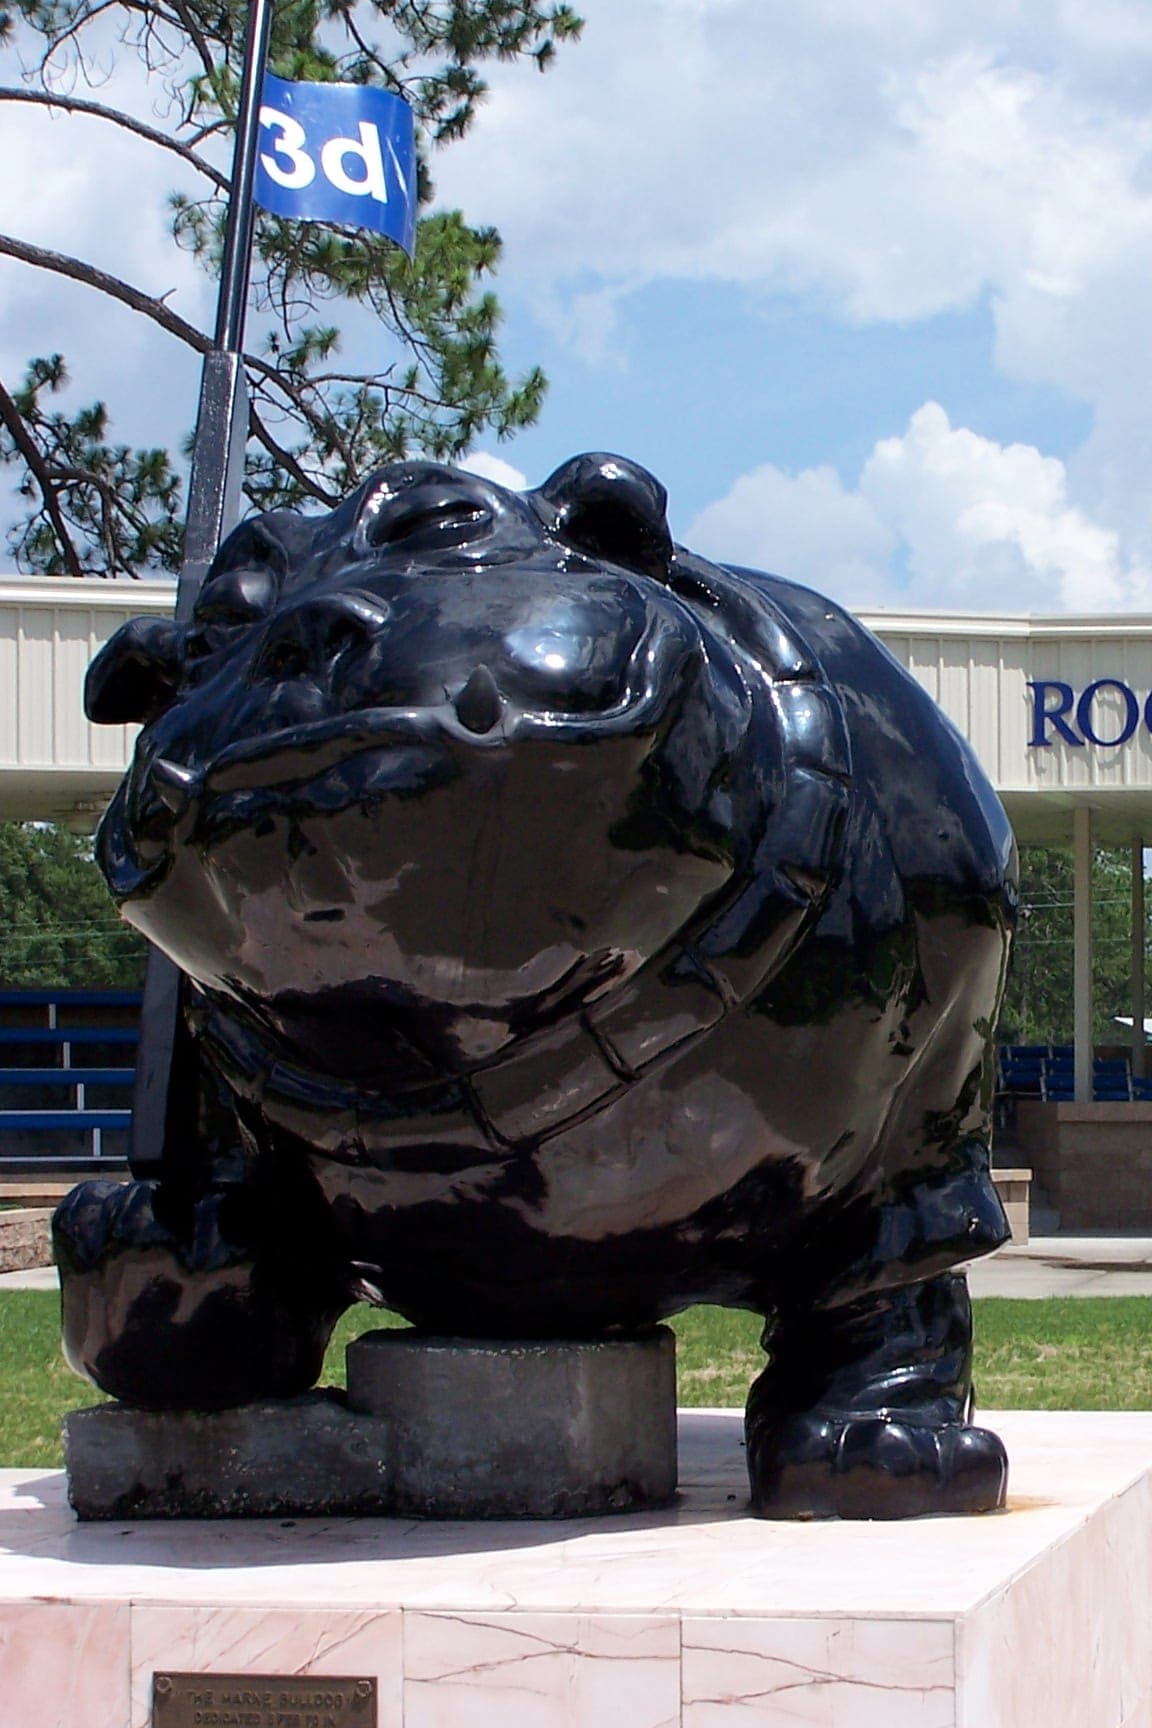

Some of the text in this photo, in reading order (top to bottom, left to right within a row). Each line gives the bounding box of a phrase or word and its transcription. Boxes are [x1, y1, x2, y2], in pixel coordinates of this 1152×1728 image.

[259, 106, 388, 204] 3d
[187, 1688, 344, 1710] THE MARNE BULLDOG
